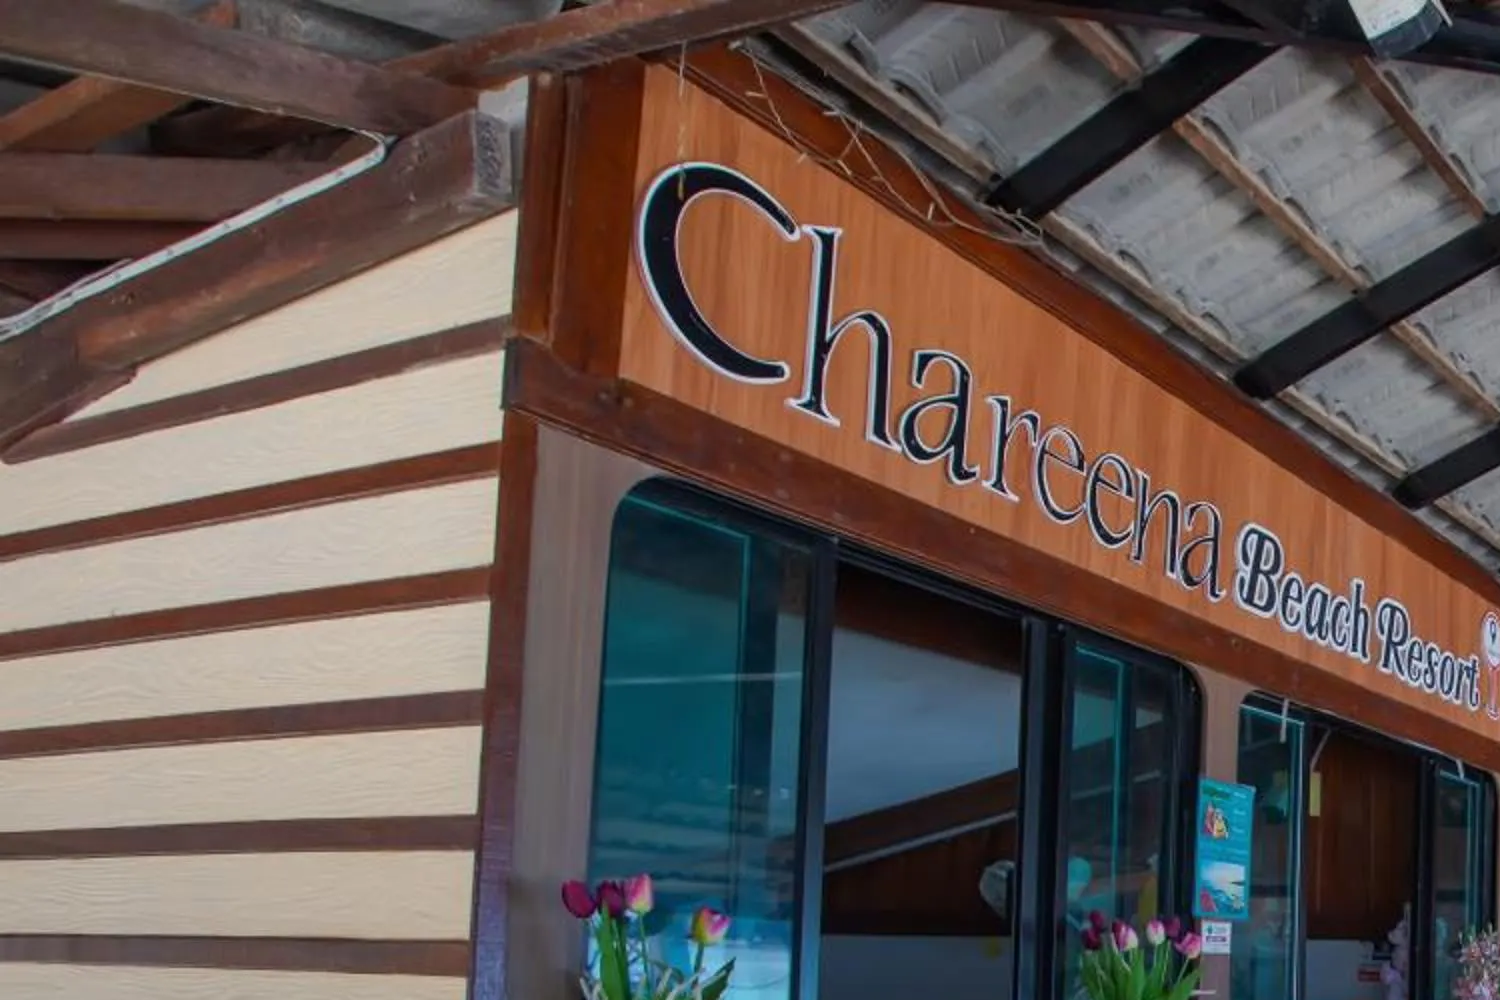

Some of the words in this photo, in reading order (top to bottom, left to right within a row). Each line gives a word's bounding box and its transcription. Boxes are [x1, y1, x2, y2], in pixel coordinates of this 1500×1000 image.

[636, 161, 1226, 601] Chareena
[1236, 523, 1372, 662] Beach
[1376, 597, 1481, 710] Resort
